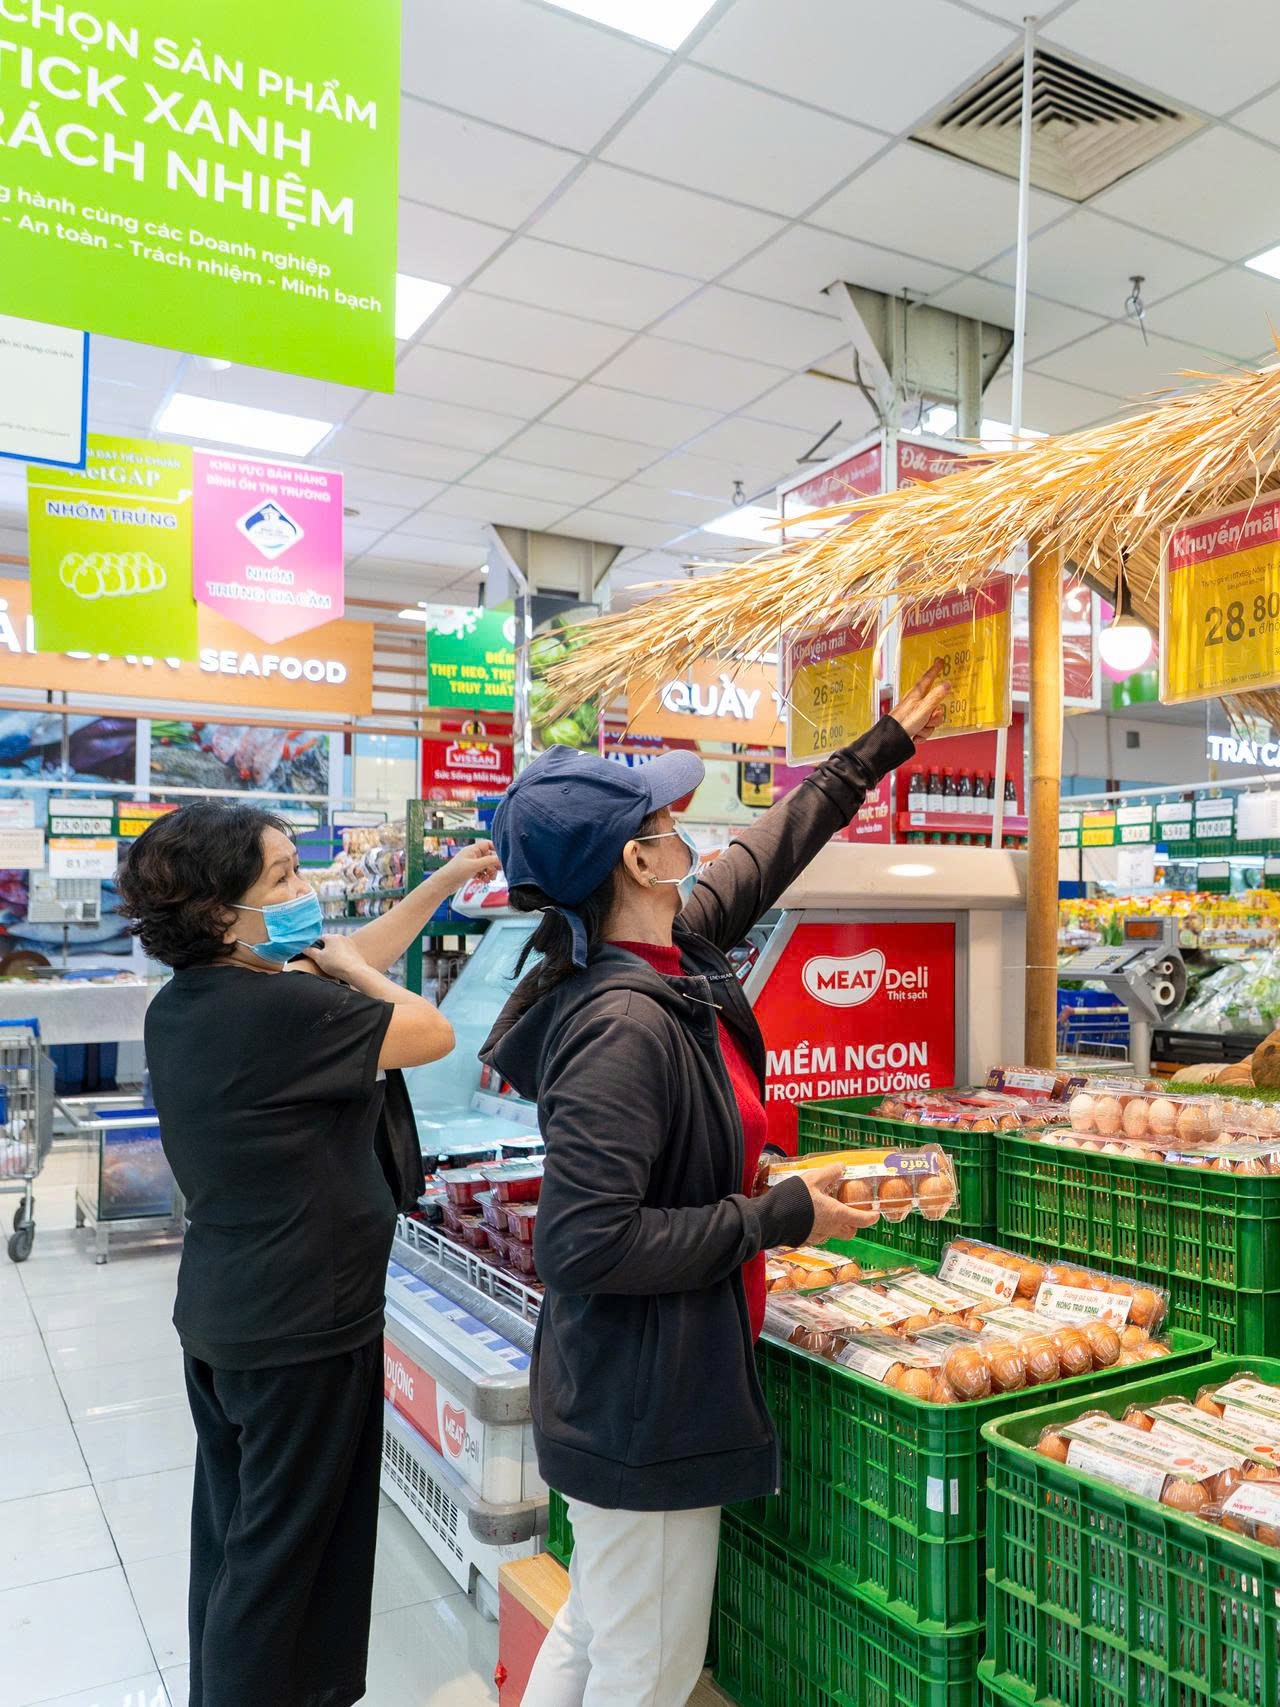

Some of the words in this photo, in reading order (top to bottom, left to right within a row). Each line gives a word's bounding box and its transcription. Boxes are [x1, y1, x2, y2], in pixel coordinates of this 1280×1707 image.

[153, 37, 244, 91] SẢN
[258, 68, 378, 130] PHẨM
[143, 81, 311, 168] XANH
[167, 149, 355, 236] NHIỆM
[18, 185, 76, 216] hành
[82, 204, 138, 234] cùng
[144, 219, 182, 242] các
[189, 229, 256, 260] Doanh
[262, 249, 331, 281] nghiệp
[18, 214, 49, 235] An
[56, 222, 108, 249] toàn
[129, 239, 191, 269] Trách
[197, 257, 262, 286] nhiệm
[282, 275, 329, 301] Minh
[335, 288, 382, 313] bạch
[1173, 519, 1241, 558] Khuyến
[1244, 508, 1280, 536] mãi
[200, 650, 347, 684] SEAFOOD
[452, 754, 495, 765] VISSAN
[817, 969, 877, 990] MEAT
[885, 966, 929, 989] Deli
[887, 989, 906, 1002] Thịt
[907, 990, 928, 1002] sạch
[765, 1040, 837, 1075] MỀM
[844, 1041, 928, 1077] NGON
[817, 1078, 862, 1097] DINH
[865, 1071, 931, 1094] DƯỠNG
[387, 1355, 414, 1400] DƯỠNG
[445, 1415, 465, 1446] MEAT
[465, 1432, 480, 1464] Deli
